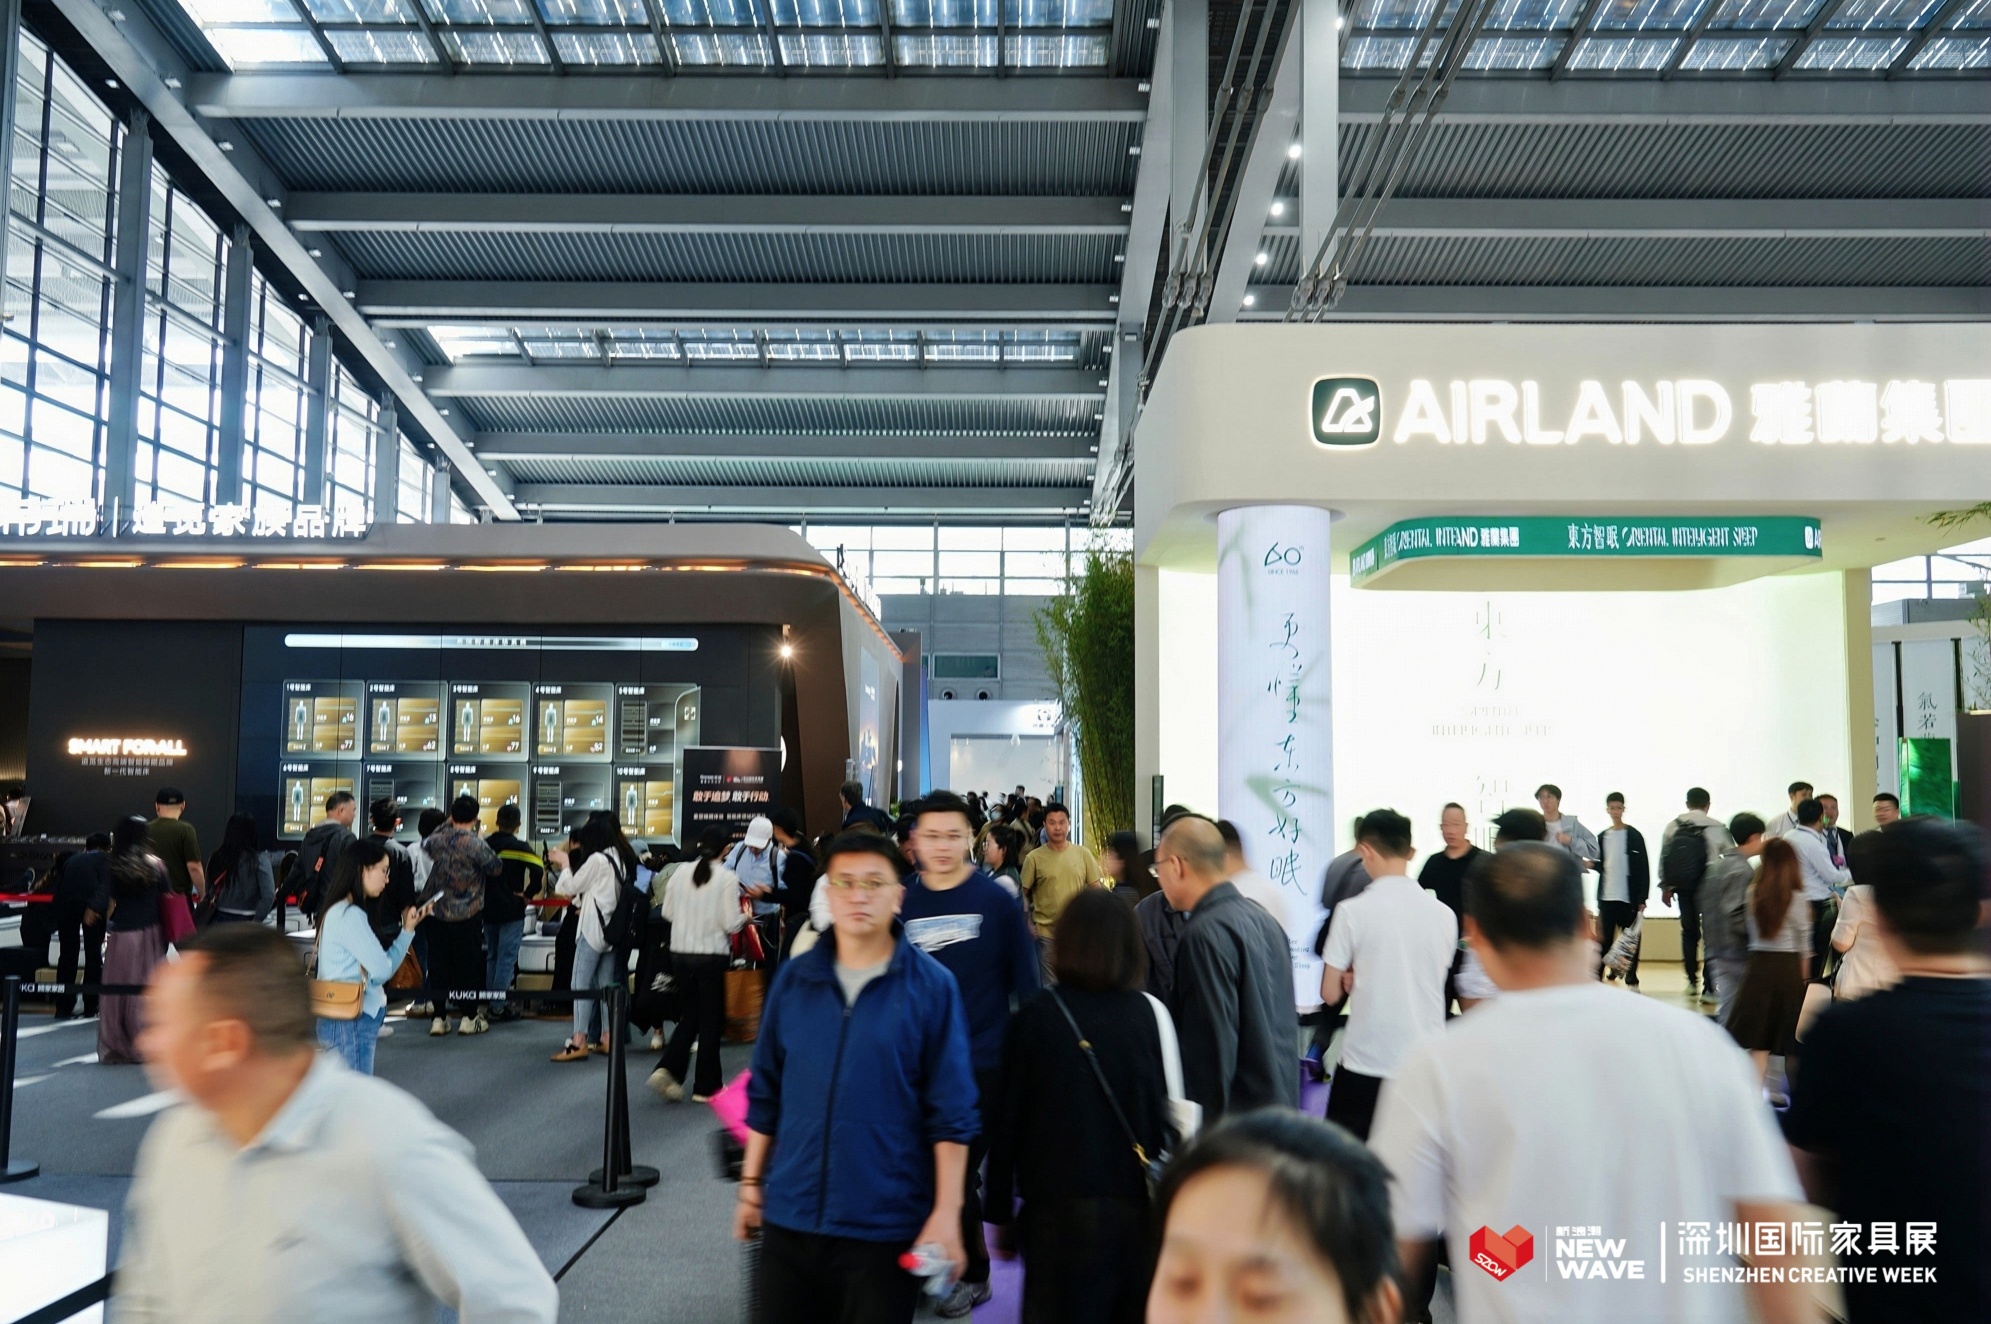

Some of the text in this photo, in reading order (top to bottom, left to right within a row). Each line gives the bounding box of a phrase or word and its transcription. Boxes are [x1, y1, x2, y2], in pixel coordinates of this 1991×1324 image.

[1394, 380, 1731, 444] AIRLAND
[1567, 523, 1619, 549] 東方智眠
[1917, 691, 1937, 739] 氣若
[68, 738, 121, 755] SMART
